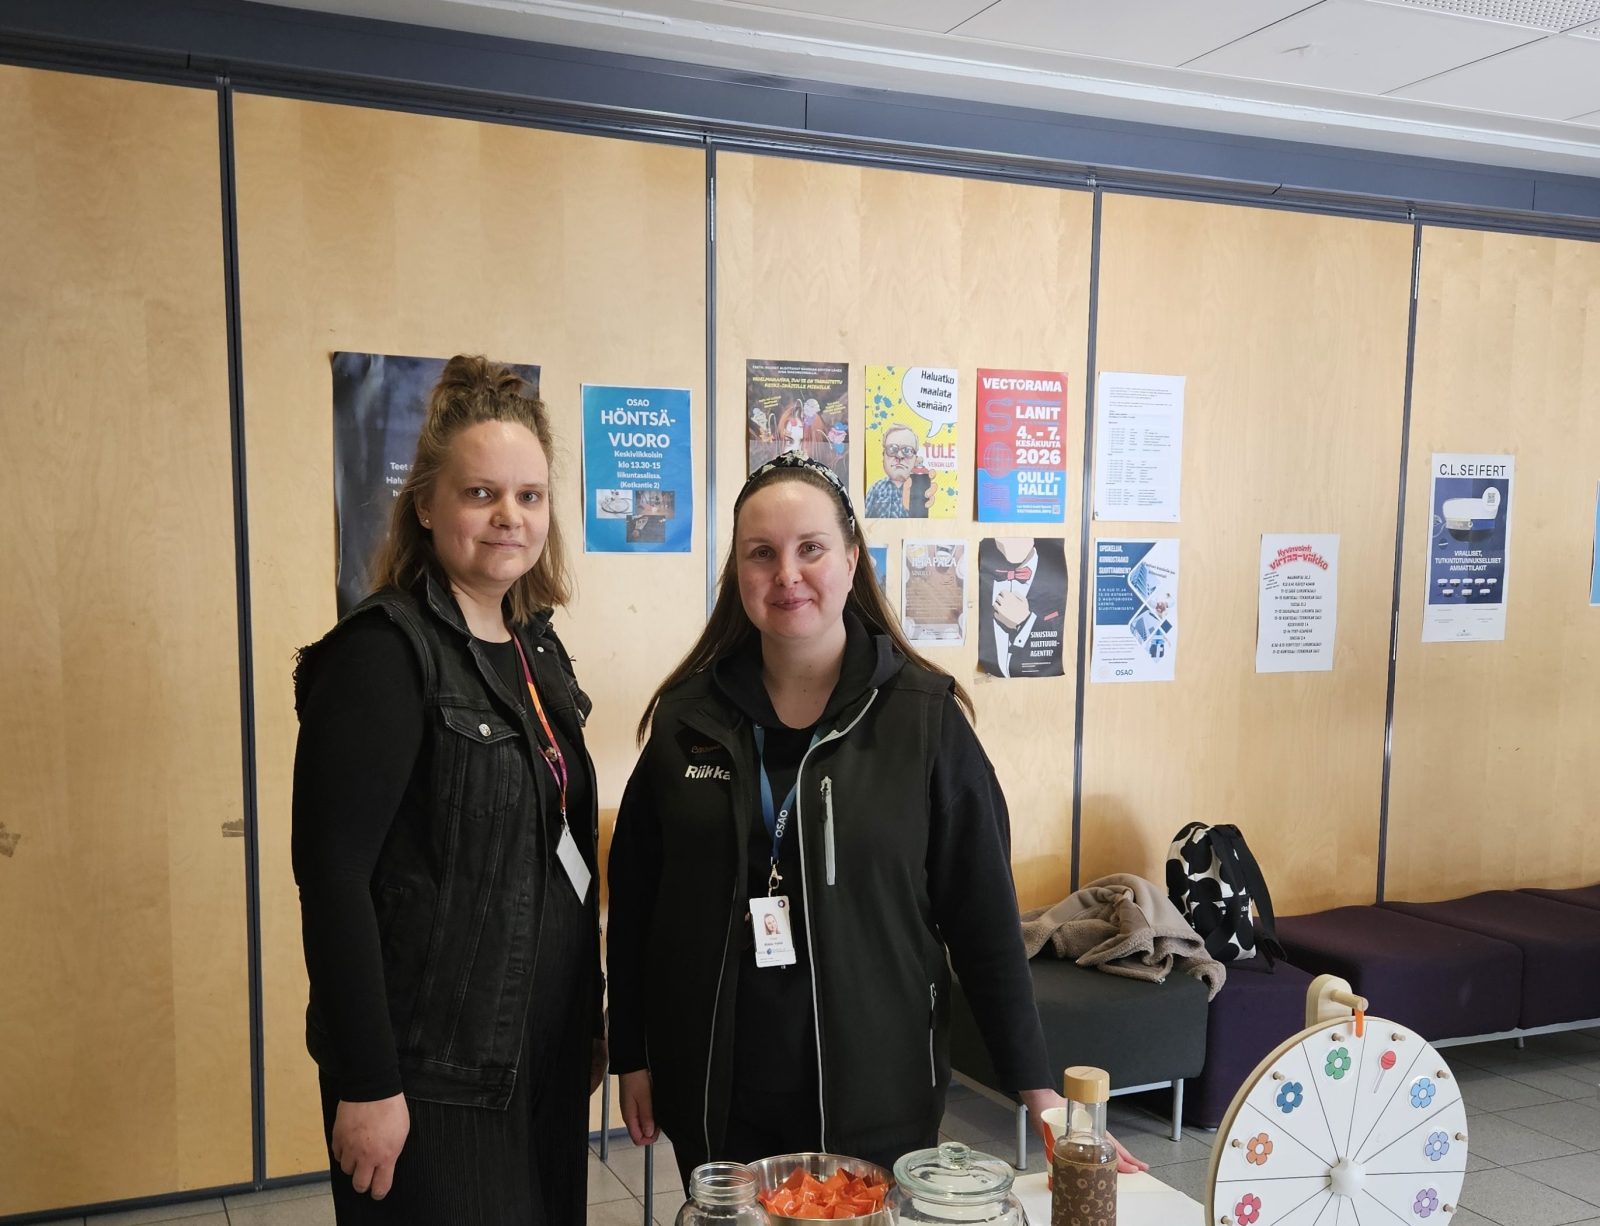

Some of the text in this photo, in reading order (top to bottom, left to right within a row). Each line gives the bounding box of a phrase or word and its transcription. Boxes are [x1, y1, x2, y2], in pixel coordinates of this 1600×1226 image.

[920, 370, 955, 385] Haluatko
[983, 377, 1063, 392] VECTORAMA
[920, 386, 952, 399] maalata
[626, 398, 650, 407] OSAO
[917, 400, 953, 413] seinään?
[601, 407, 676, 427] HÖNTSÄ-
[1016, 405, 1062, 420] LANIT
[1017, 425, 1033, 440] 4.
[1048, 426, 1061, 440] 7.
[608, 432, 670, 448] VUORO
[1016, 438, 1062, 448] KESÄKUUTA
[614, 450, 663, 459] Keskiviikkoisin
[923, 441, 956, 459] TULE
[1016, 449, 1062, 464] 2026
[390, 462, 408, 471] Teet
[618, 461, 661, 469] klo 13.30-15
[1439, 463, 1507, 477] C.L.SEIFERT
[1017, 471, 1062, 484] OULU-
[1018, 483, 1059, 496] HALLI
[1030, 631, 1058, 639] SINUSTAKO
[1030, 640, 1060, 648] KULTTUURI-
[1030, 649, 1054, 657] AGENTTI?
[1115, 669, 1133, 677] OSAO
[684, 764, 731, 781] Riikka
[775, 809, 789, 838] OSAO
